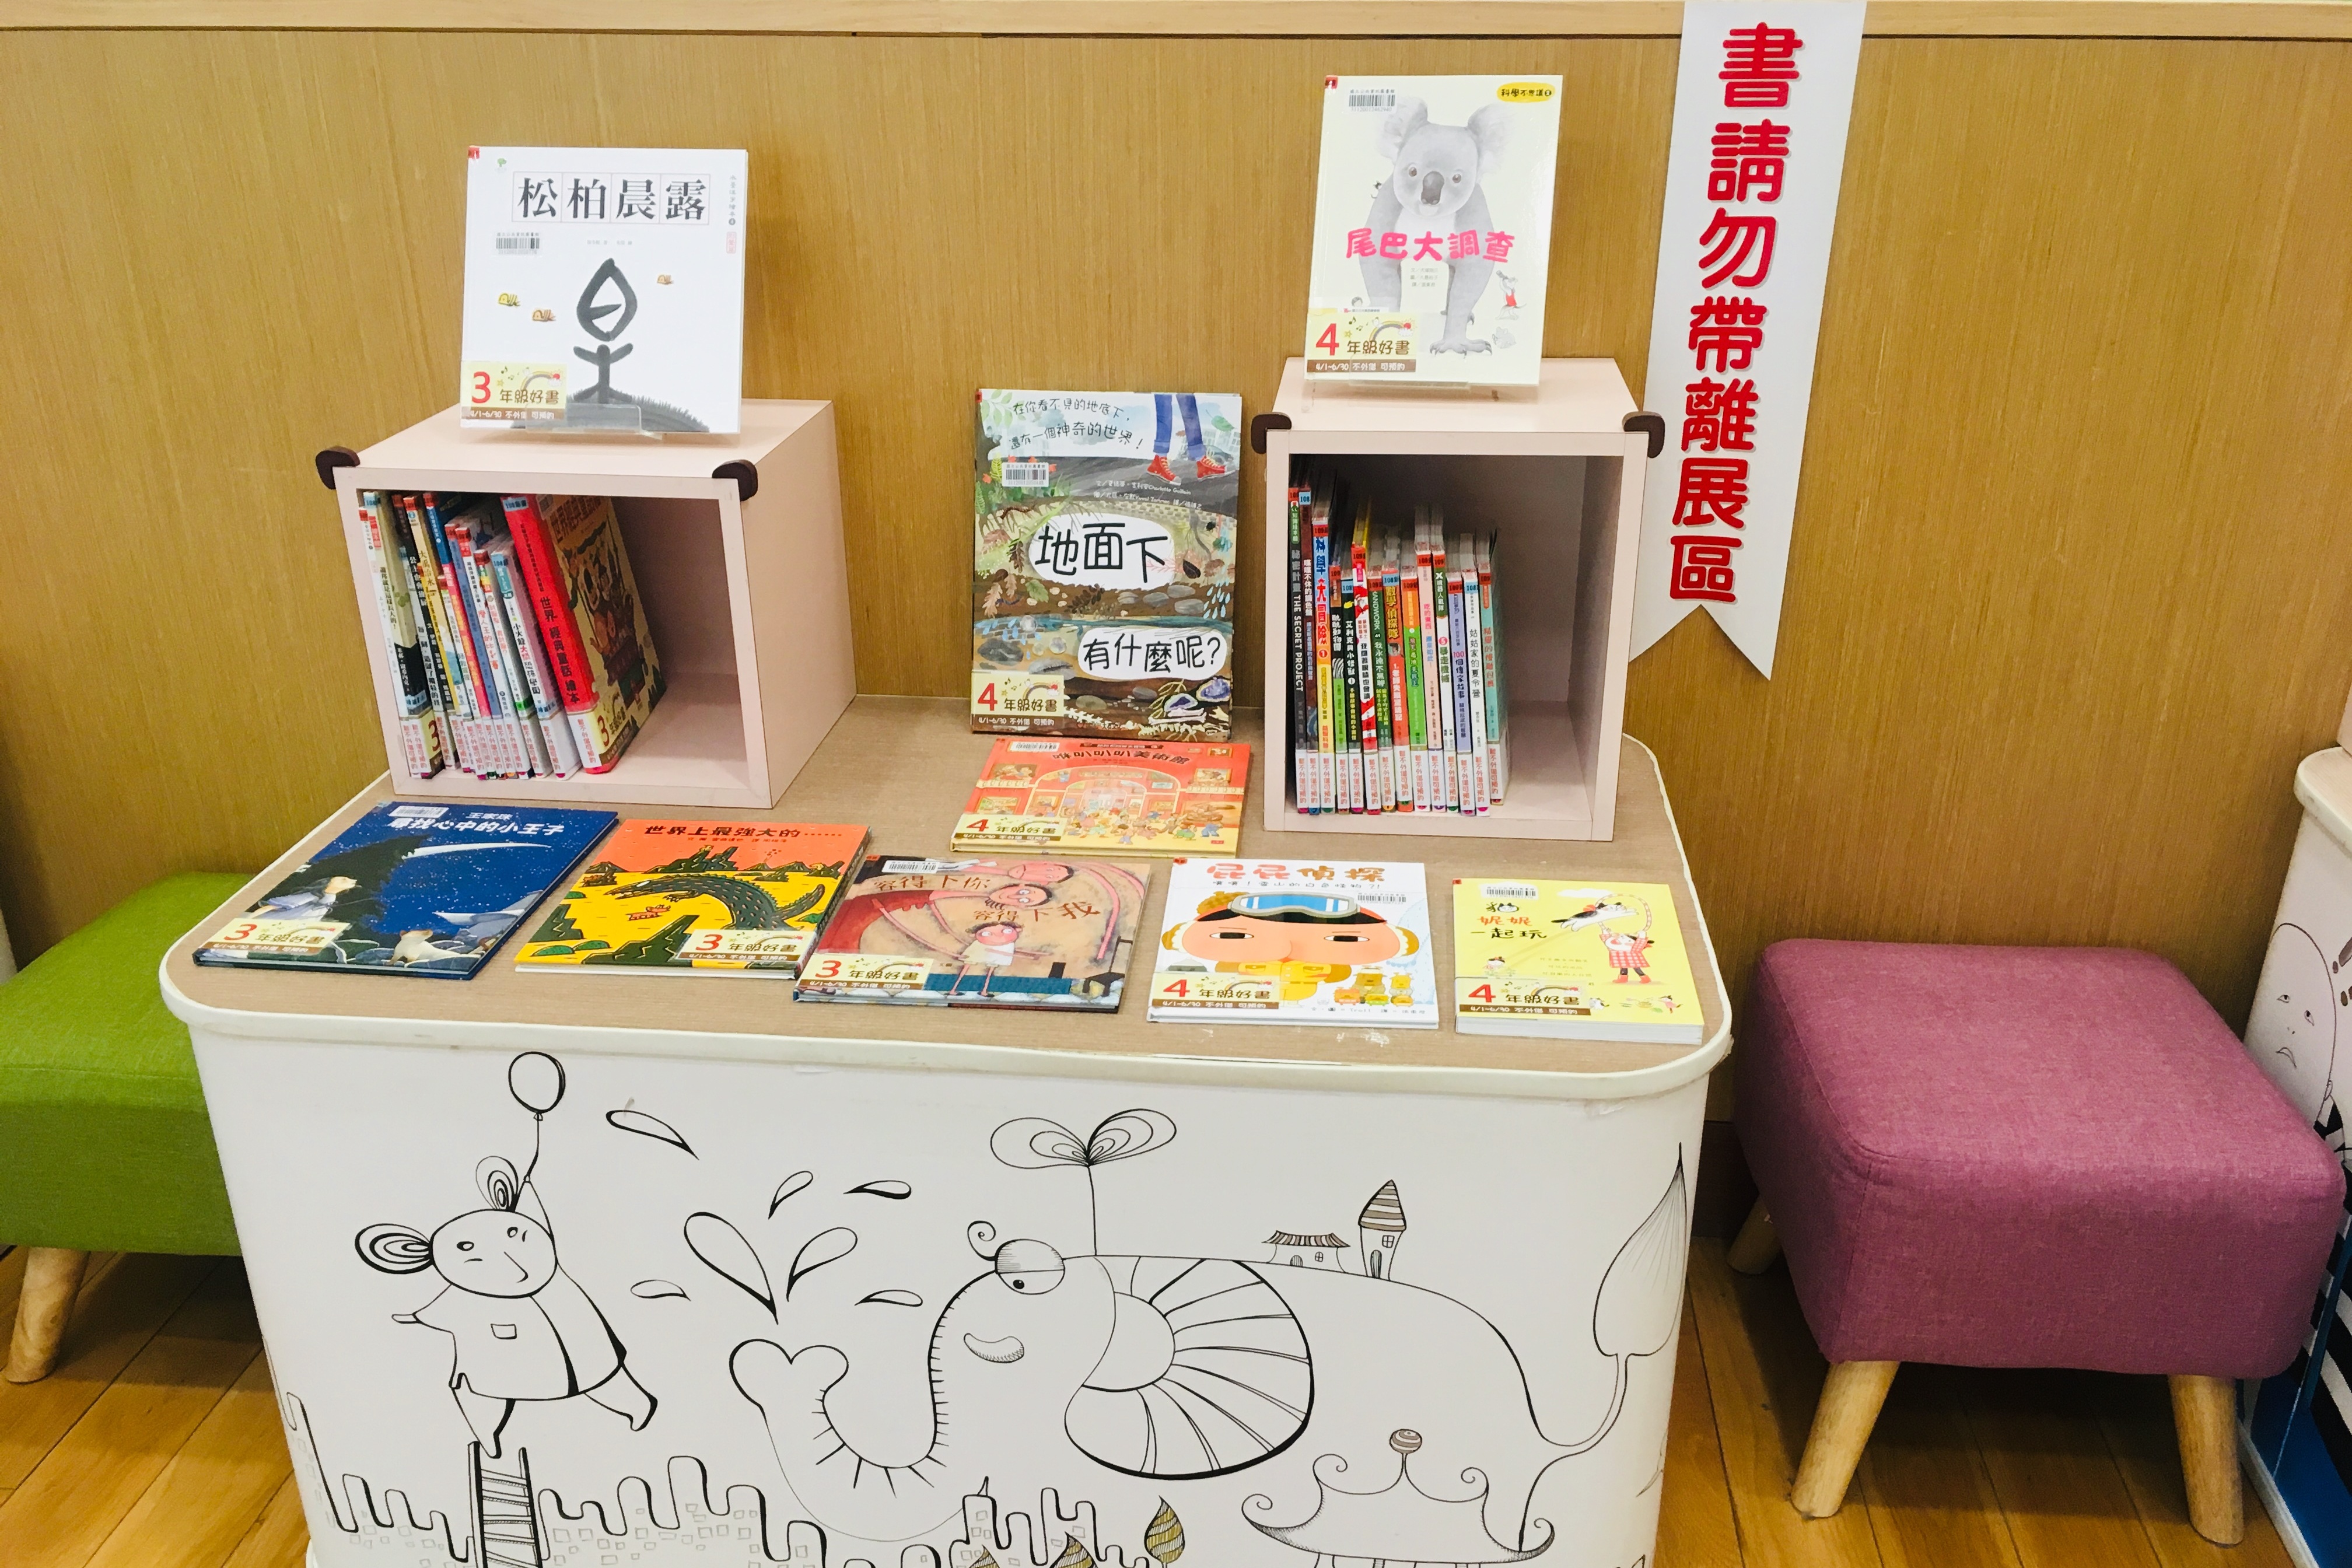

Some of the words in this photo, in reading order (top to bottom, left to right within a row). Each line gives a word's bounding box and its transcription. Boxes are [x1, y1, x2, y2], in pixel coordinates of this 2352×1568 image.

[517, 178, 706, 220] 松柏晨露
[1346, 228, 1515, 263] 尾巴大調查
[1670, 22, 1804, 604] 書請勿帶離展區
[1315, 323, 1339, 355] 4
[1347, 340, 1410, 355] 年級好書
[471, 372, 491, 404] 3
[499, 390, 559, 404] 年級好書
[1035, 523, 1168, 583] 地面下
[1293, 594, 1301, 612] THE
[1294, 616, 1303, 649] SECRET
[1332, 614, 1342, 652] 動物園
[1083, 634, 1220, 673] 有什麼呢?
[1470, 629, 1480, 698] 姑姑家的夏令營
[1296, 652, 1304, 691] PROJECT
[977, 683, 998, 711] 4
[1003, 698, 1058, 712] 年級好書
[597, 715, 610, 747] 3
[387, 818, 565, 835] 尋找心中的小王子
[965, 818, 989, 832] 4
[874, 874, 992, 890] 容得下你
[1207, 863, 1385, 881] 屁屁偵探
[974, 901, 1100, 922] 容得下我
[1478, 916, 1532, 926] 妮妮
[223, 924, 258, 940] 3
[256, 933, 325, 944] 年級好書
[695, 934, 723, 951] 3
[727, 943, 797, 953] 年級好書
[1471, 928, 1547, 939] 一起玩
[816, 960, 842, 978] 3
[848, 970, 919, 981] 年級好書
[1163, 980, 1190, 997] 4
[1199, 989, 1271, 999] 年級好書
[1468, 984, 1496, 1003] 4
[1506, 995, 1580, 1005] 年級好書
